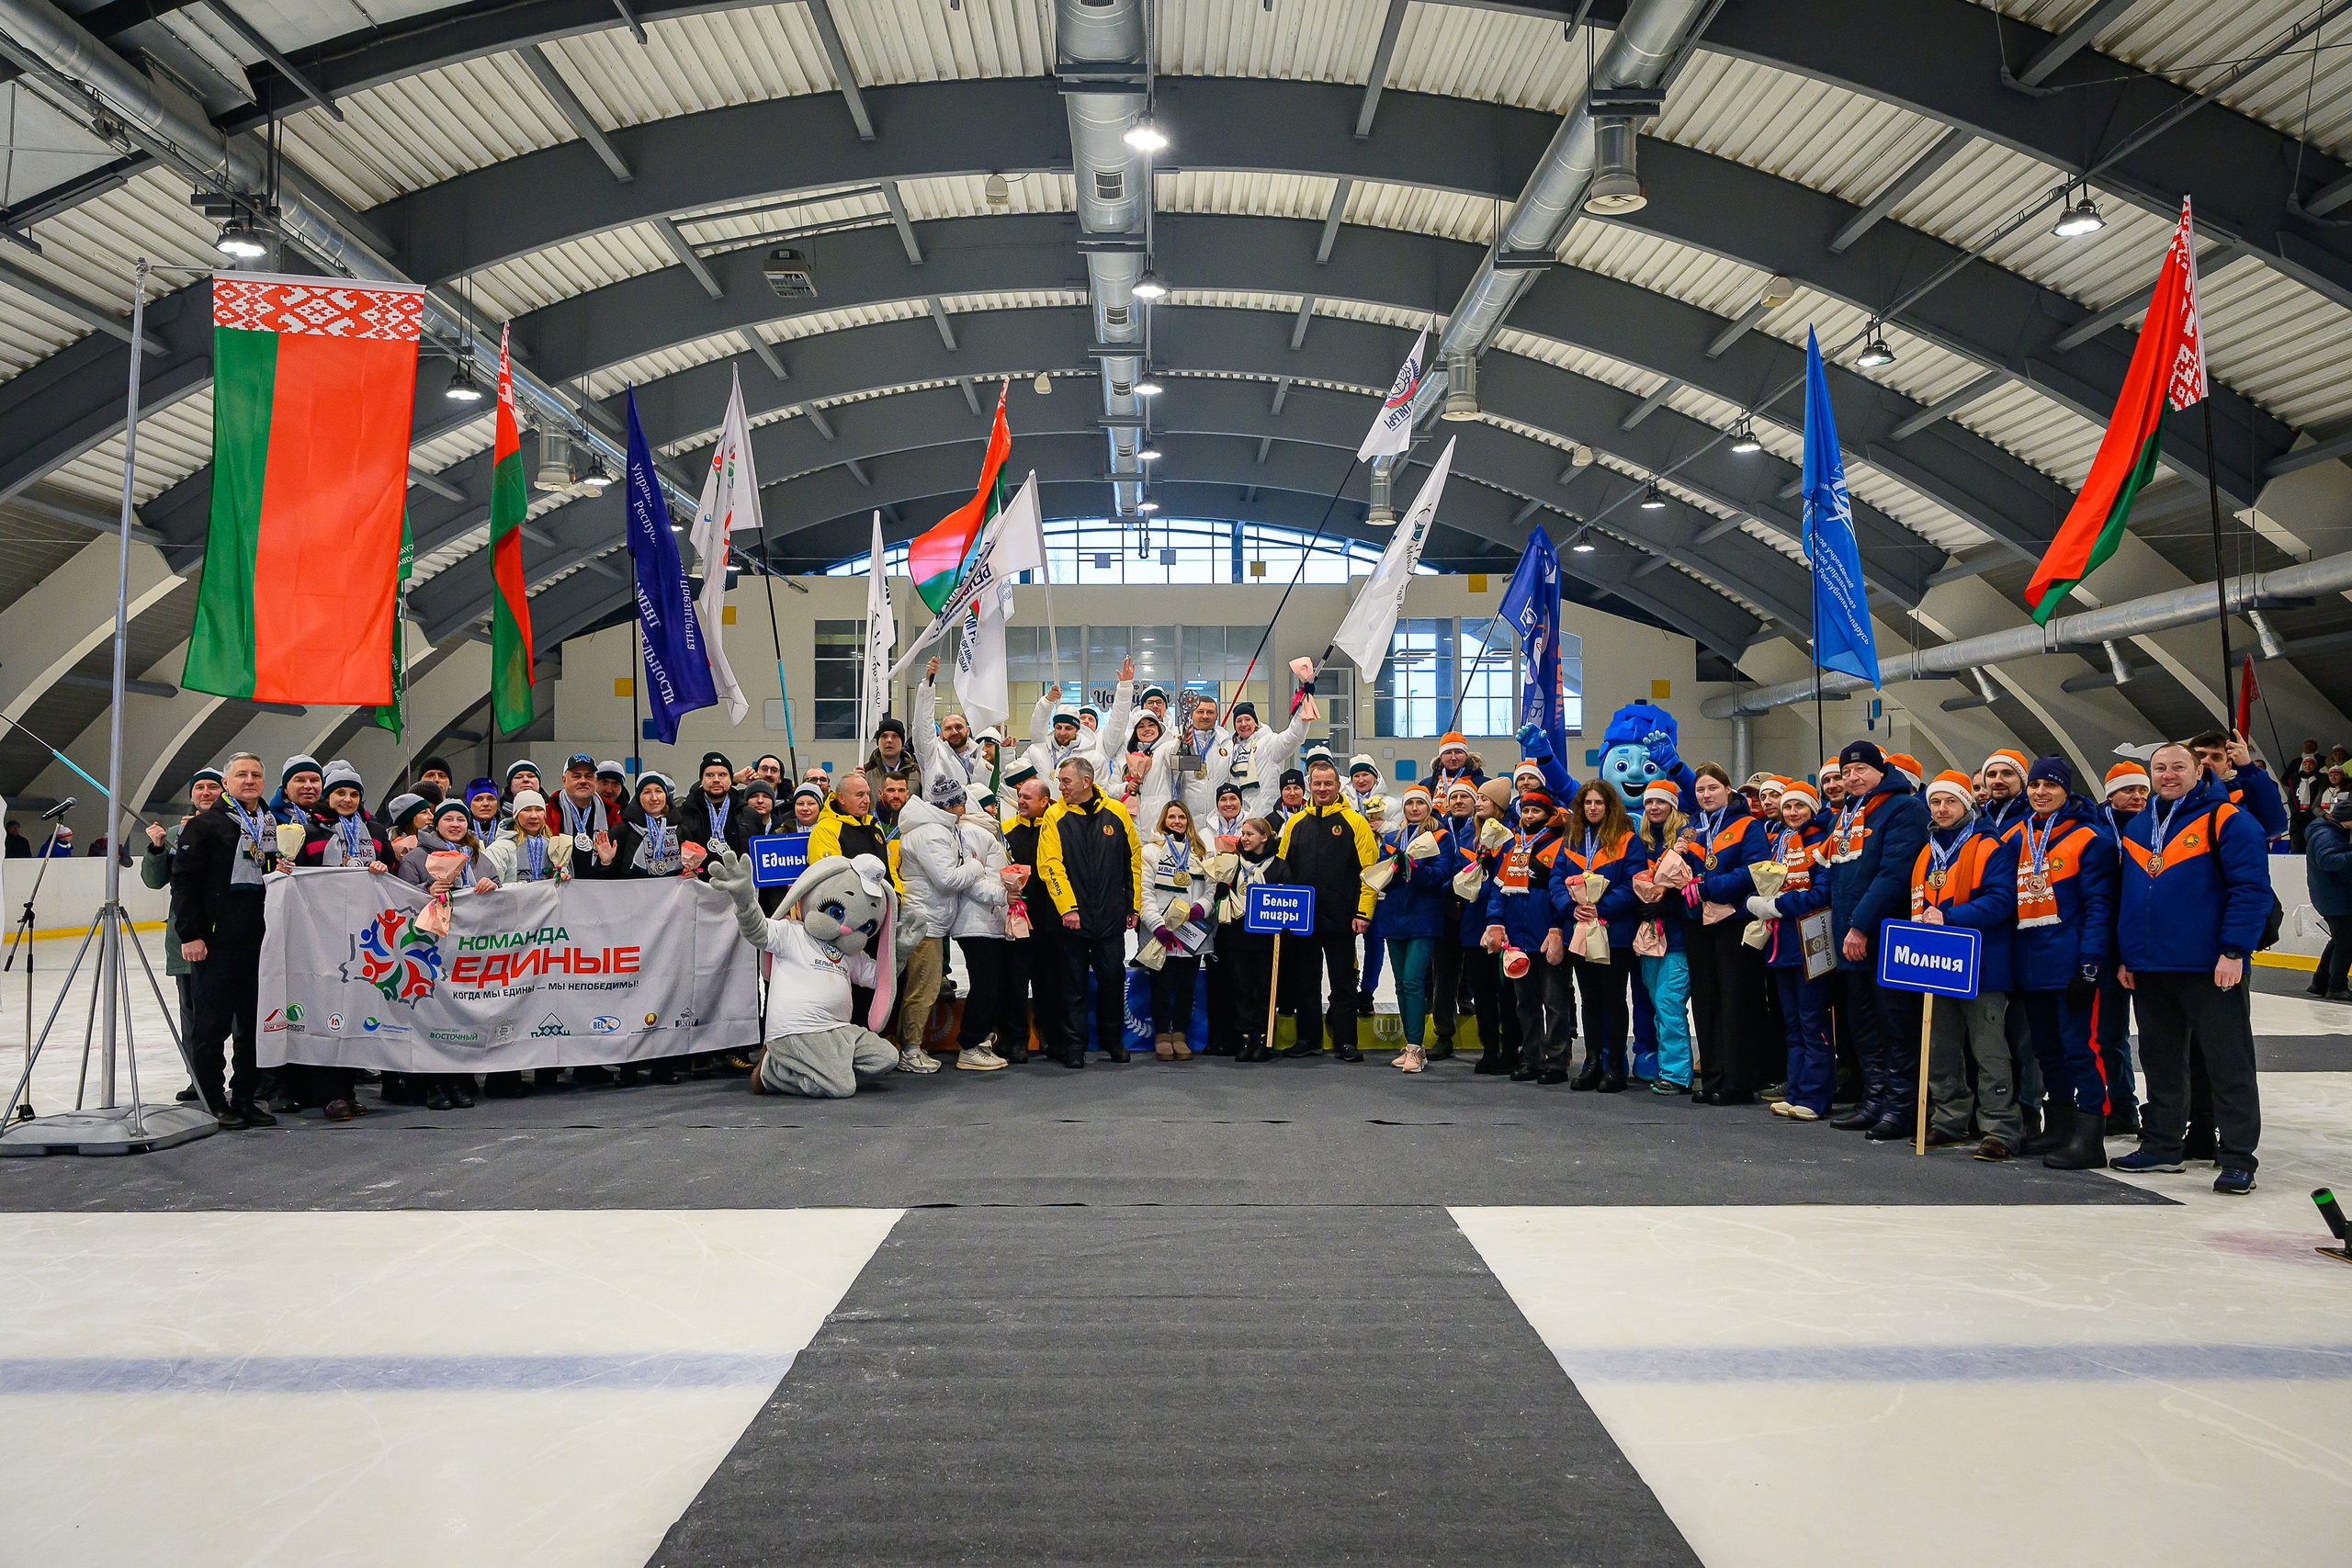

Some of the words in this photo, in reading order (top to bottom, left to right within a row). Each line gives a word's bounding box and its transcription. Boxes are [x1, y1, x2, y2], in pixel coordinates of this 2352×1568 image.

[631, 463, 652, 507] Управ
[1825, 547, 1855, 589] учреждение
[1817, 567, 1848, 611] Республики
[762, 852, 808, 868] Едины
[1048, 867, 1062, 896] BELARUS
[1263, 894, 1298, 908] Белые
[1260, 910, 1299, 924] тигры
[458, 927, 570, 951] КОМАНДА
[1820, 915, 1832, 966] СЕРТИФИКАТ
[451, 946, 640, 988] ЕДИНЫЕ
[1894, 945, 1963, 973] Молния
[453, 991, 481, 1000] КОГДА
[483, 990, 500, 998] МЫ
[503, 985, 535, 997] ЕДИНЫ
[568, 980, 639, 990] НЕПОБЕДИМЫ!
[430, 1032, 478, 1041] ВОСТОЧНЫЙ
[1378, 1018, 1399, 1032] III
